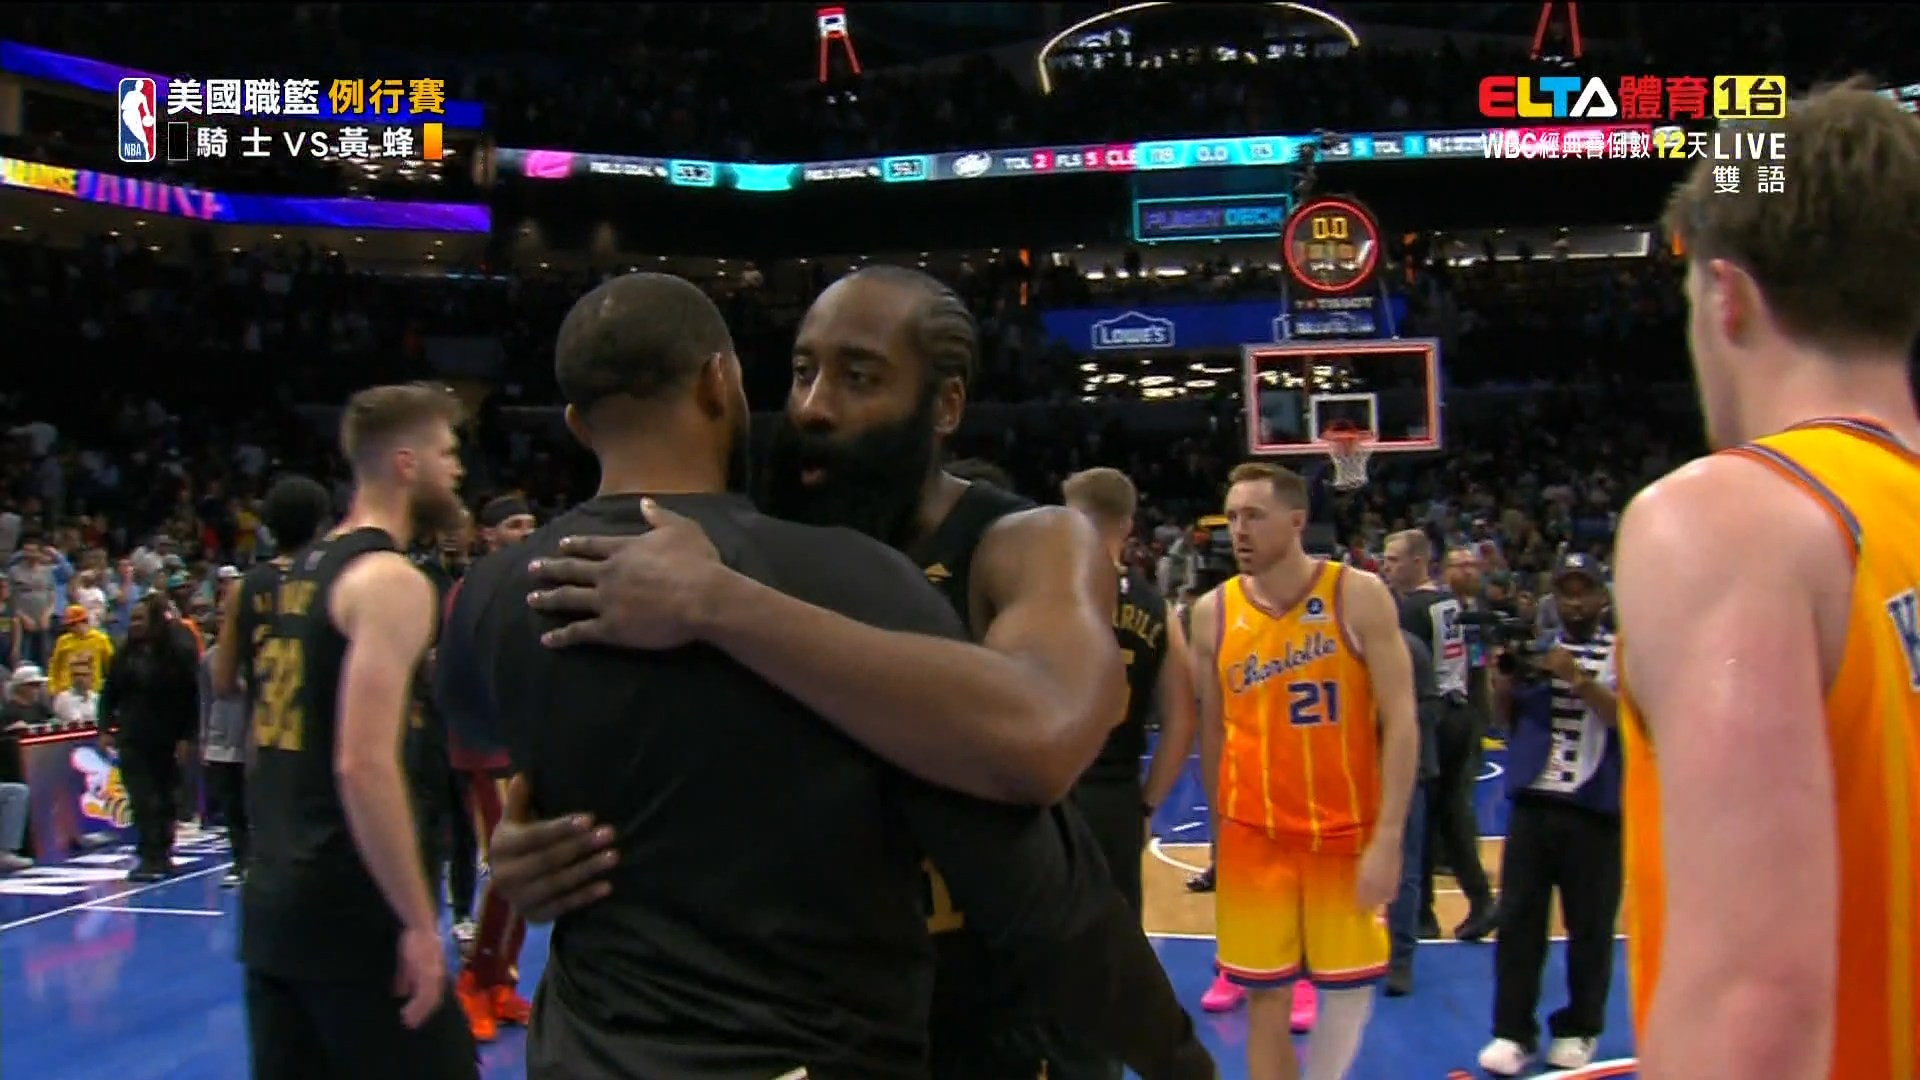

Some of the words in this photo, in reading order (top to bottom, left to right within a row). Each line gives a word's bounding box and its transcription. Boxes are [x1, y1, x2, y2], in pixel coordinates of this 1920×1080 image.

[1034, 154, 1048, 168] 2
[1112, 602, 1164, 649] RILL
[1228, 632, 1336, 693] Charlotte
[1287, 680, 1338, 726] 21
